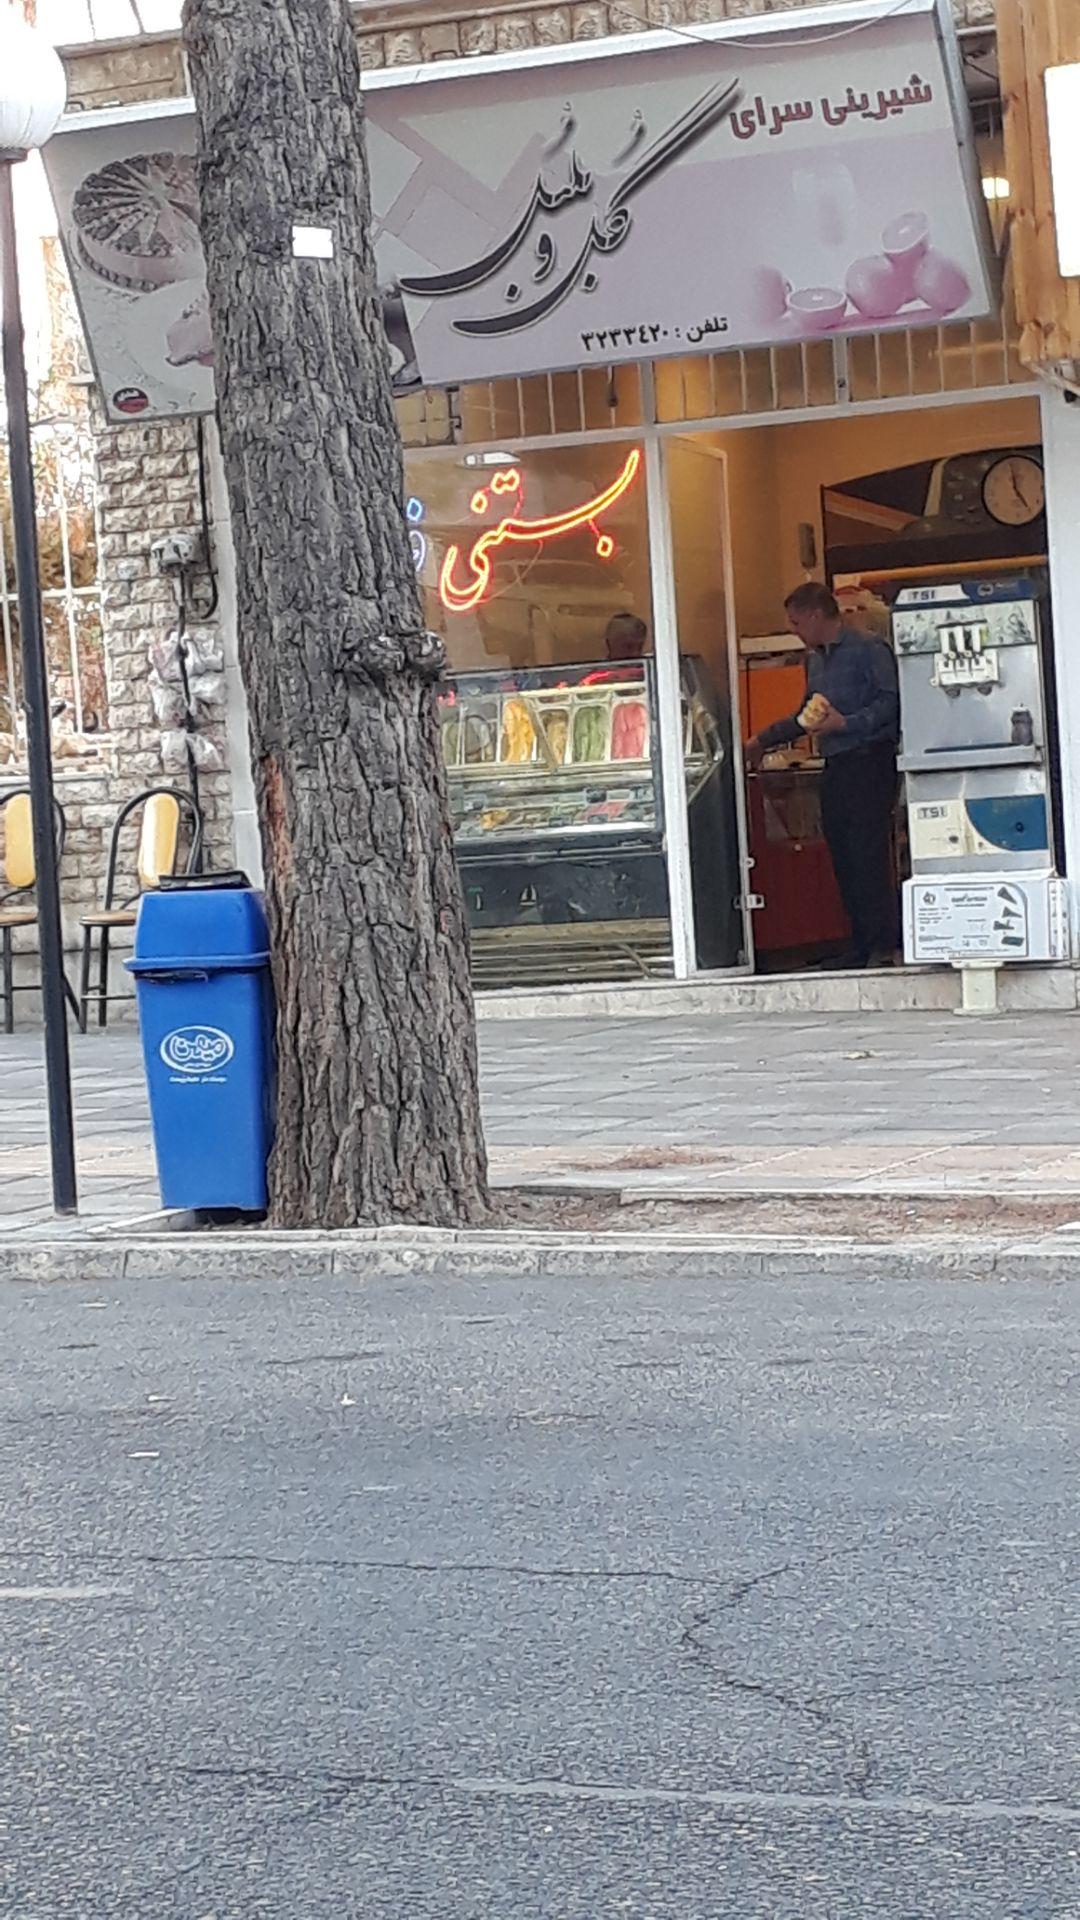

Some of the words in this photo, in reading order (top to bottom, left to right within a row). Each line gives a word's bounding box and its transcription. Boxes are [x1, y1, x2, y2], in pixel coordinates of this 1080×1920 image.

[729, 96, 813, 139] سرای
[821, 74, 932, 126] شیرینی
[451, 76, 742, 338] گل
[532, 230, 560, 283] و
[439, 449, 639, 611] بستنی
[911, 589, 936, 600] TSI
[920, 806, 947, 819] TSI
